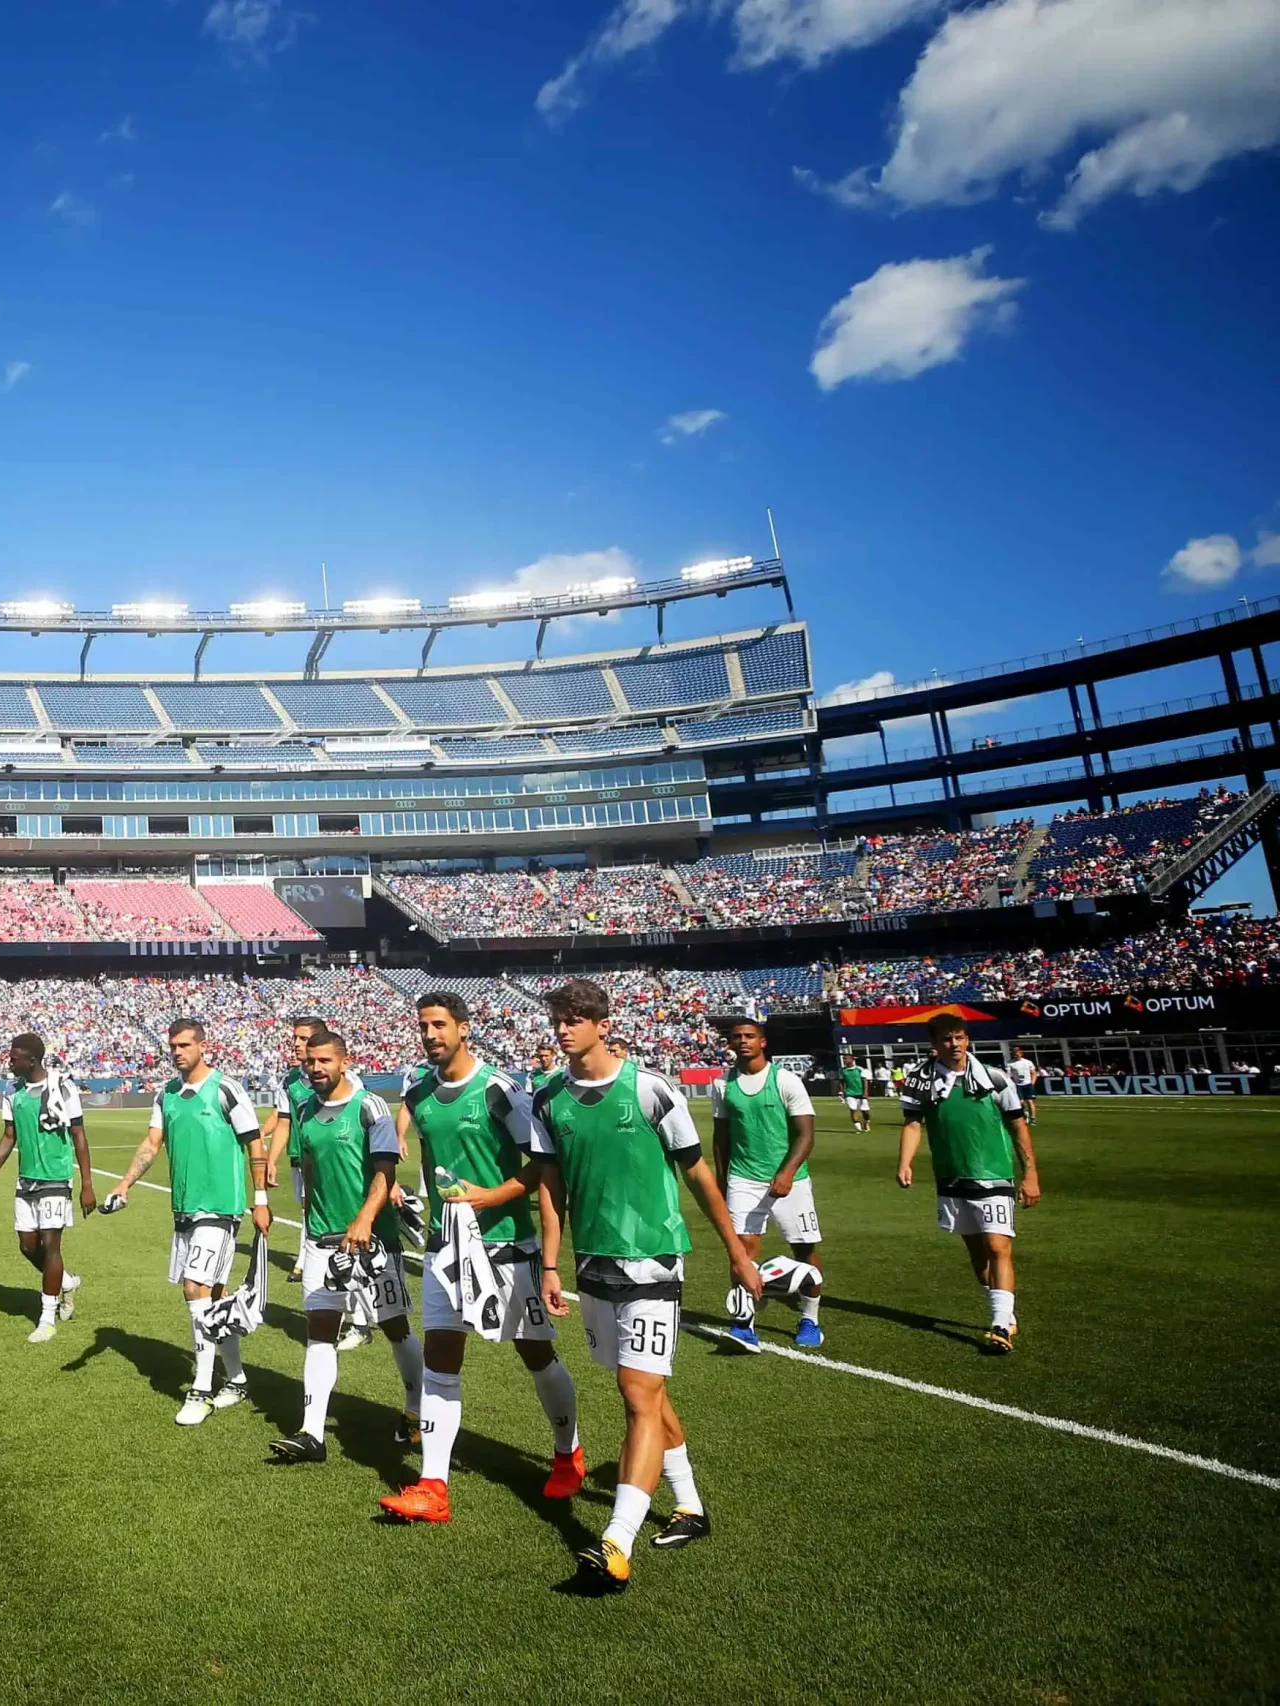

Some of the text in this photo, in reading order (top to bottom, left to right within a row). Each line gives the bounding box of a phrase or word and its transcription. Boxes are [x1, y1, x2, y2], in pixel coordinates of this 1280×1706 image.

[647, 932, 675, 945] ROMA
[1043, 1002, 1111, 1017] OPTUM
[1146, 996, 1214, 1012] OPTUM
[1044, 1073, 1257, 1095] CHEVROLET
[44, 1201, 63, 1220] 34
[982, 1204, 1007, 1225] 38
[797, 1211, 818, 1232] 18
[189, 1245, 215, 1272] 27
[370, 1279, 397, 1309] 28
[631, 1318, 667, 1356] 35
